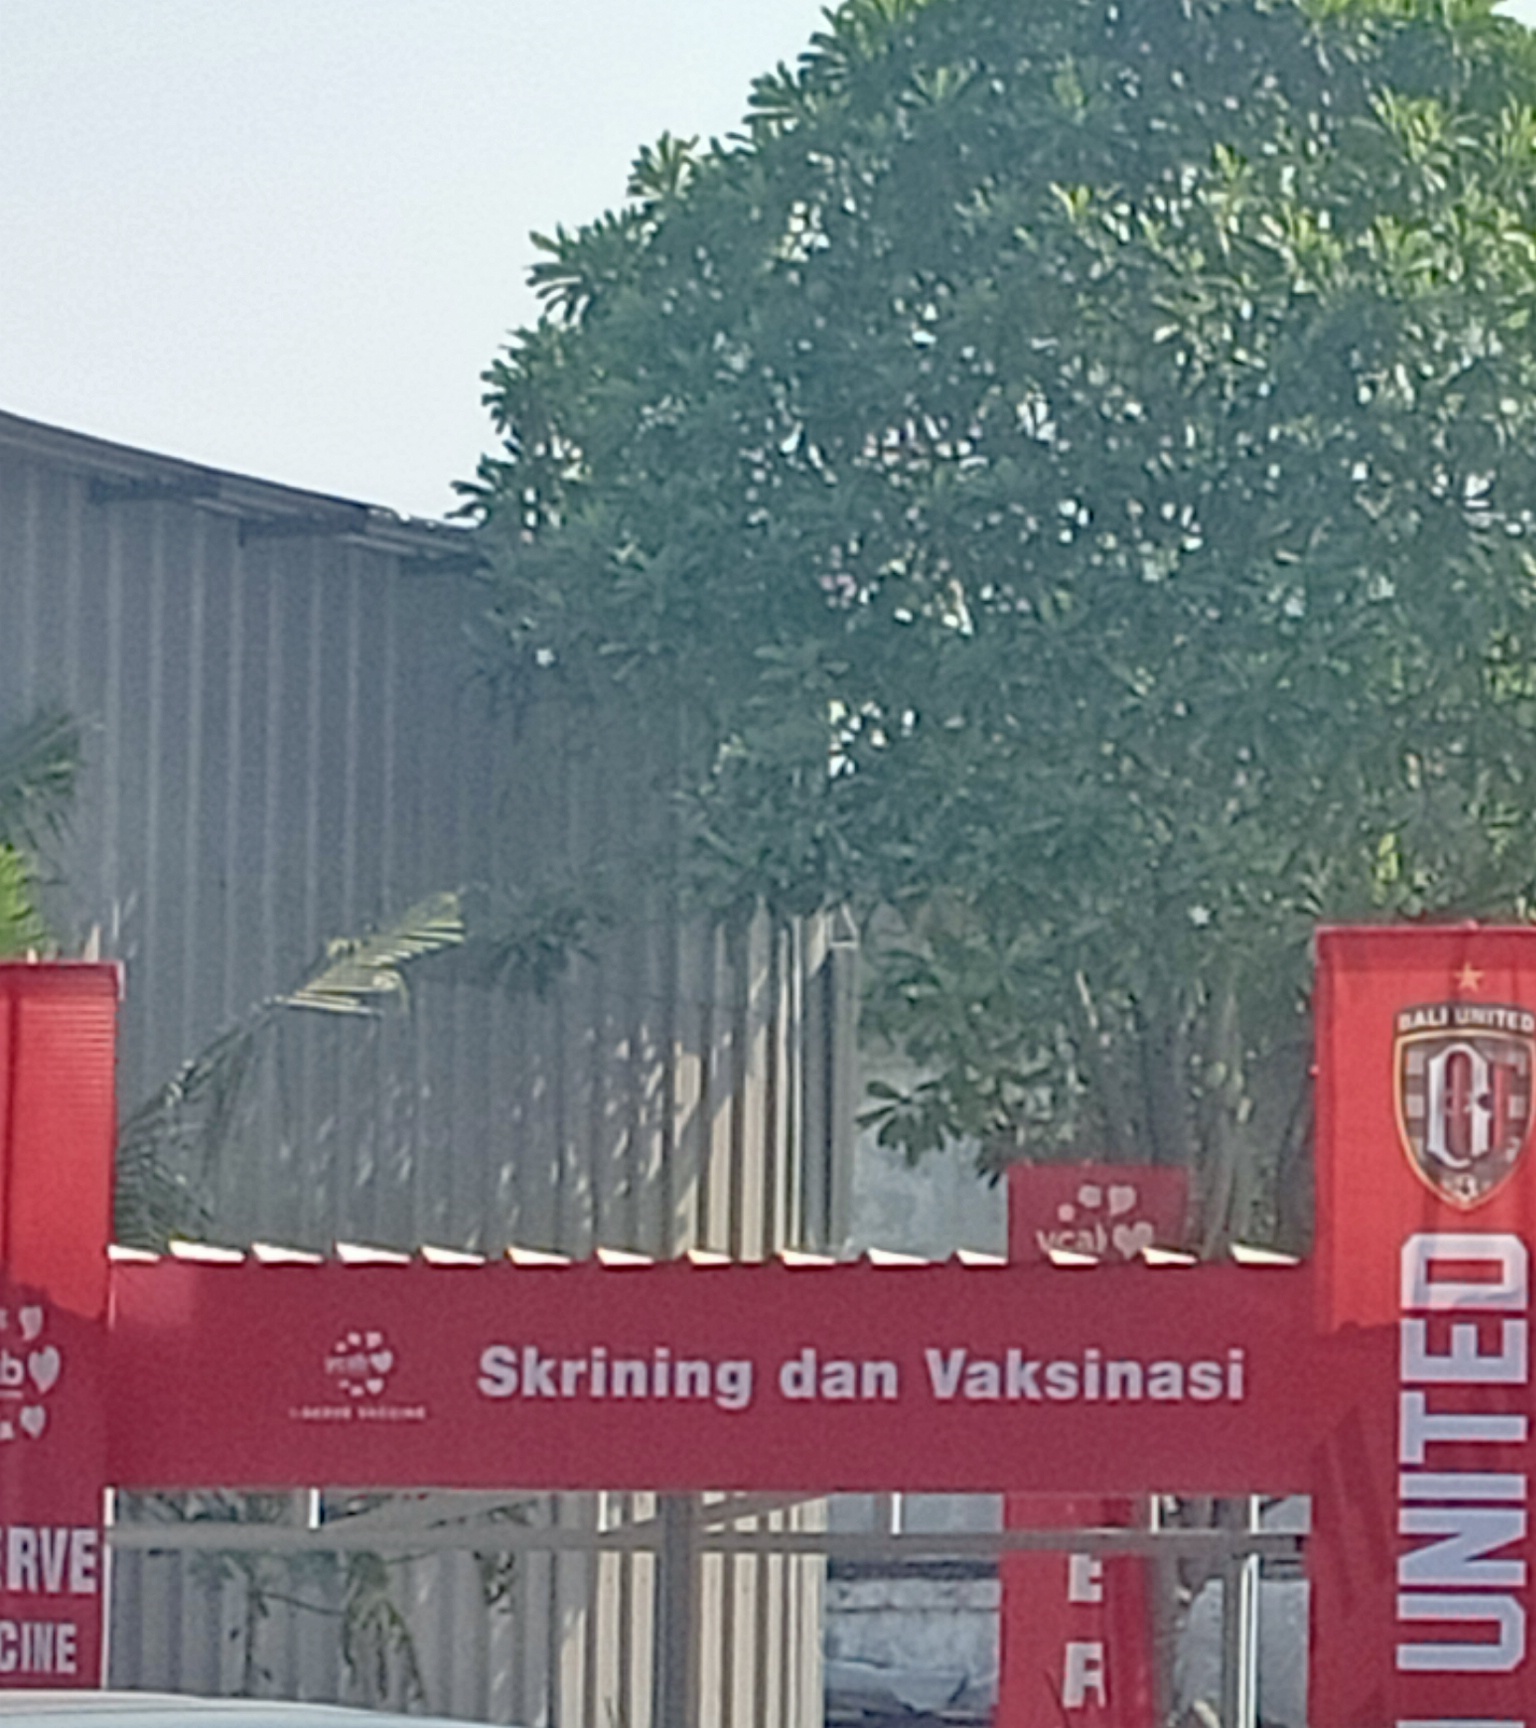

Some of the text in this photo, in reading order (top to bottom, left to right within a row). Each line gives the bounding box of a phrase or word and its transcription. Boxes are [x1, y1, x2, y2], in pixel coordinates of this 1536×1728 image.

[1454, 1007, 1536, 1033] UNITED
[478, 1345, 1244, 1410] Skrining dan Vaksinasi
[1396, 1233, 1528, 1671] UNITED
[0, 1526, 98, 1594] RVE
